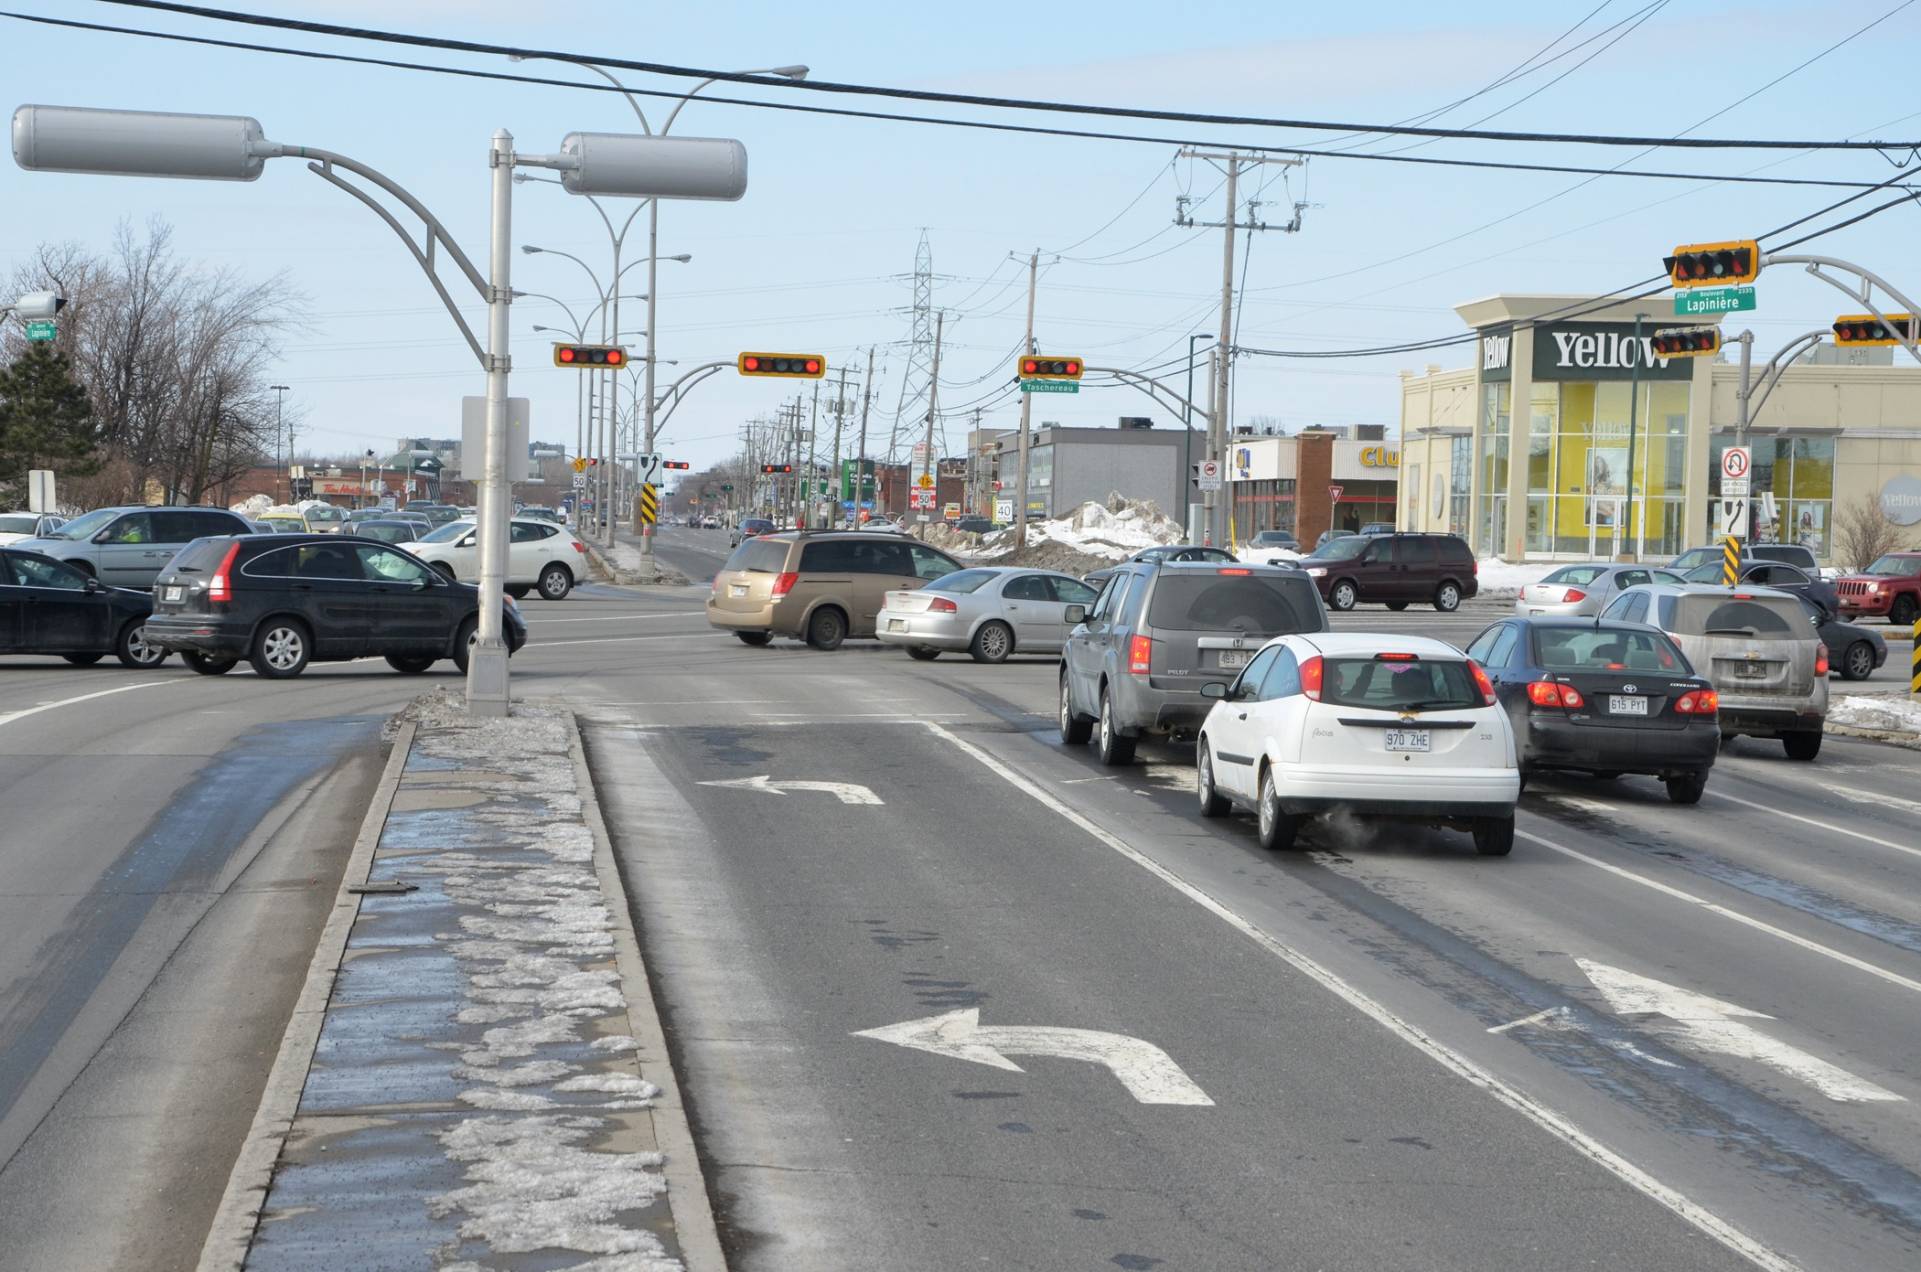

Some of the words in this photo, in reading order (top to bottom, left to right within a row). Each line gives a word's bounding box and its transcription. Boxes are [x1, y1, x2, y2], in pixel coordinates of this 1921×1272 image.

[1687, 296, 1740, 313] Lapinière
[1483, 335, 1510, 370] Yellow
[1026, 383, 1074, 392] Taschereau
[574, 477, 584, 486] 50
[919, 494, 930, 504] 50
[998, 505, 1011, 517] 40
[1611, 699, 1627, 711] 615
[1630, 700, 1646, 711] PYT
[1387, 733, 1405, 746] 970
[1410, 734, 1428, 747] ZHE
